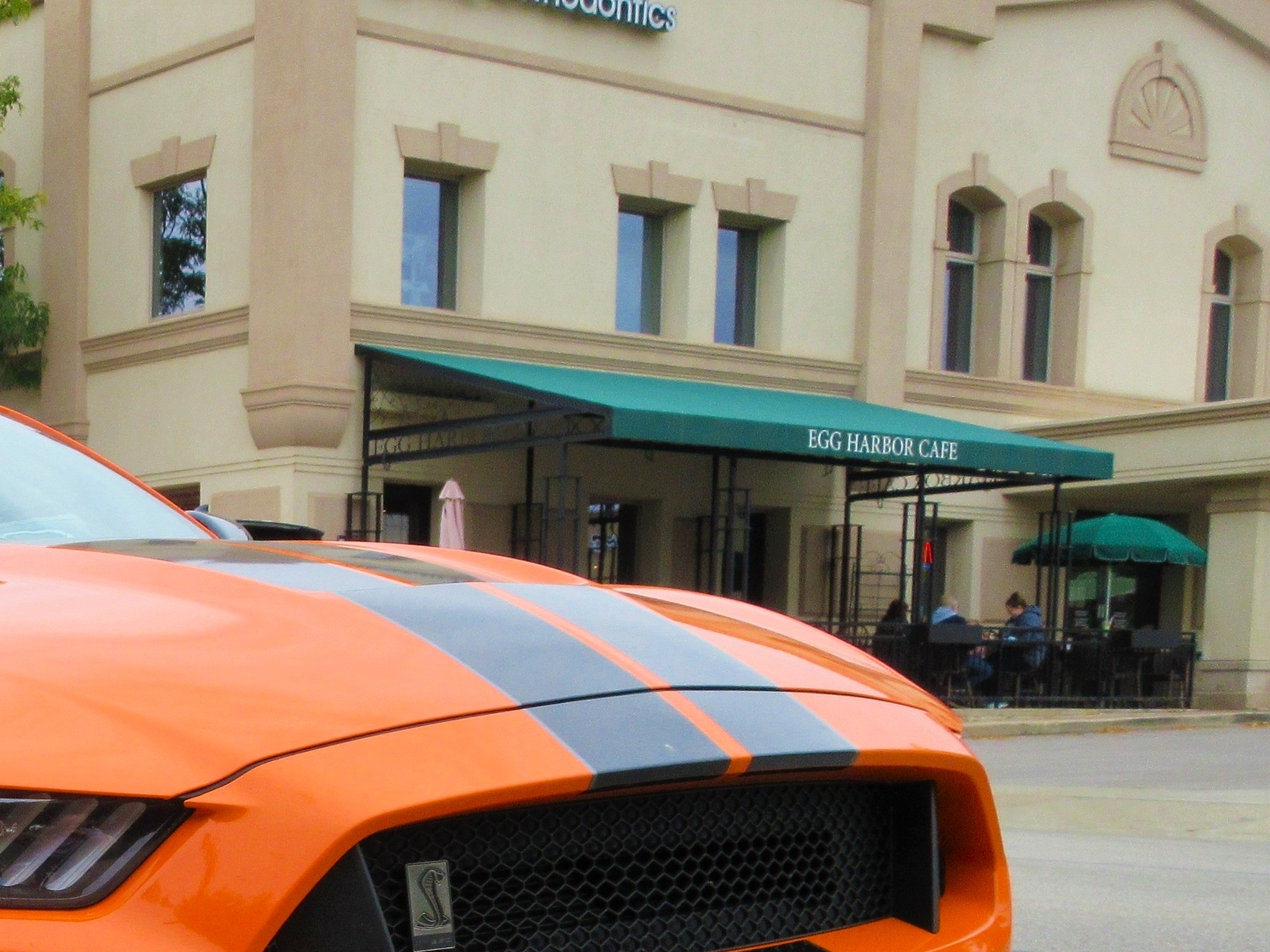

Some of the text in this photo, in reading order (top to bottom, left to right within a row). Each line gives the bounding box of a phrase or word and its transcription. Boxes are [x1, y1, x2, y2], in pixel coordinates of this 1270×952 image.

[809, 428, 959, 461] EGG HARBOR CAFE
